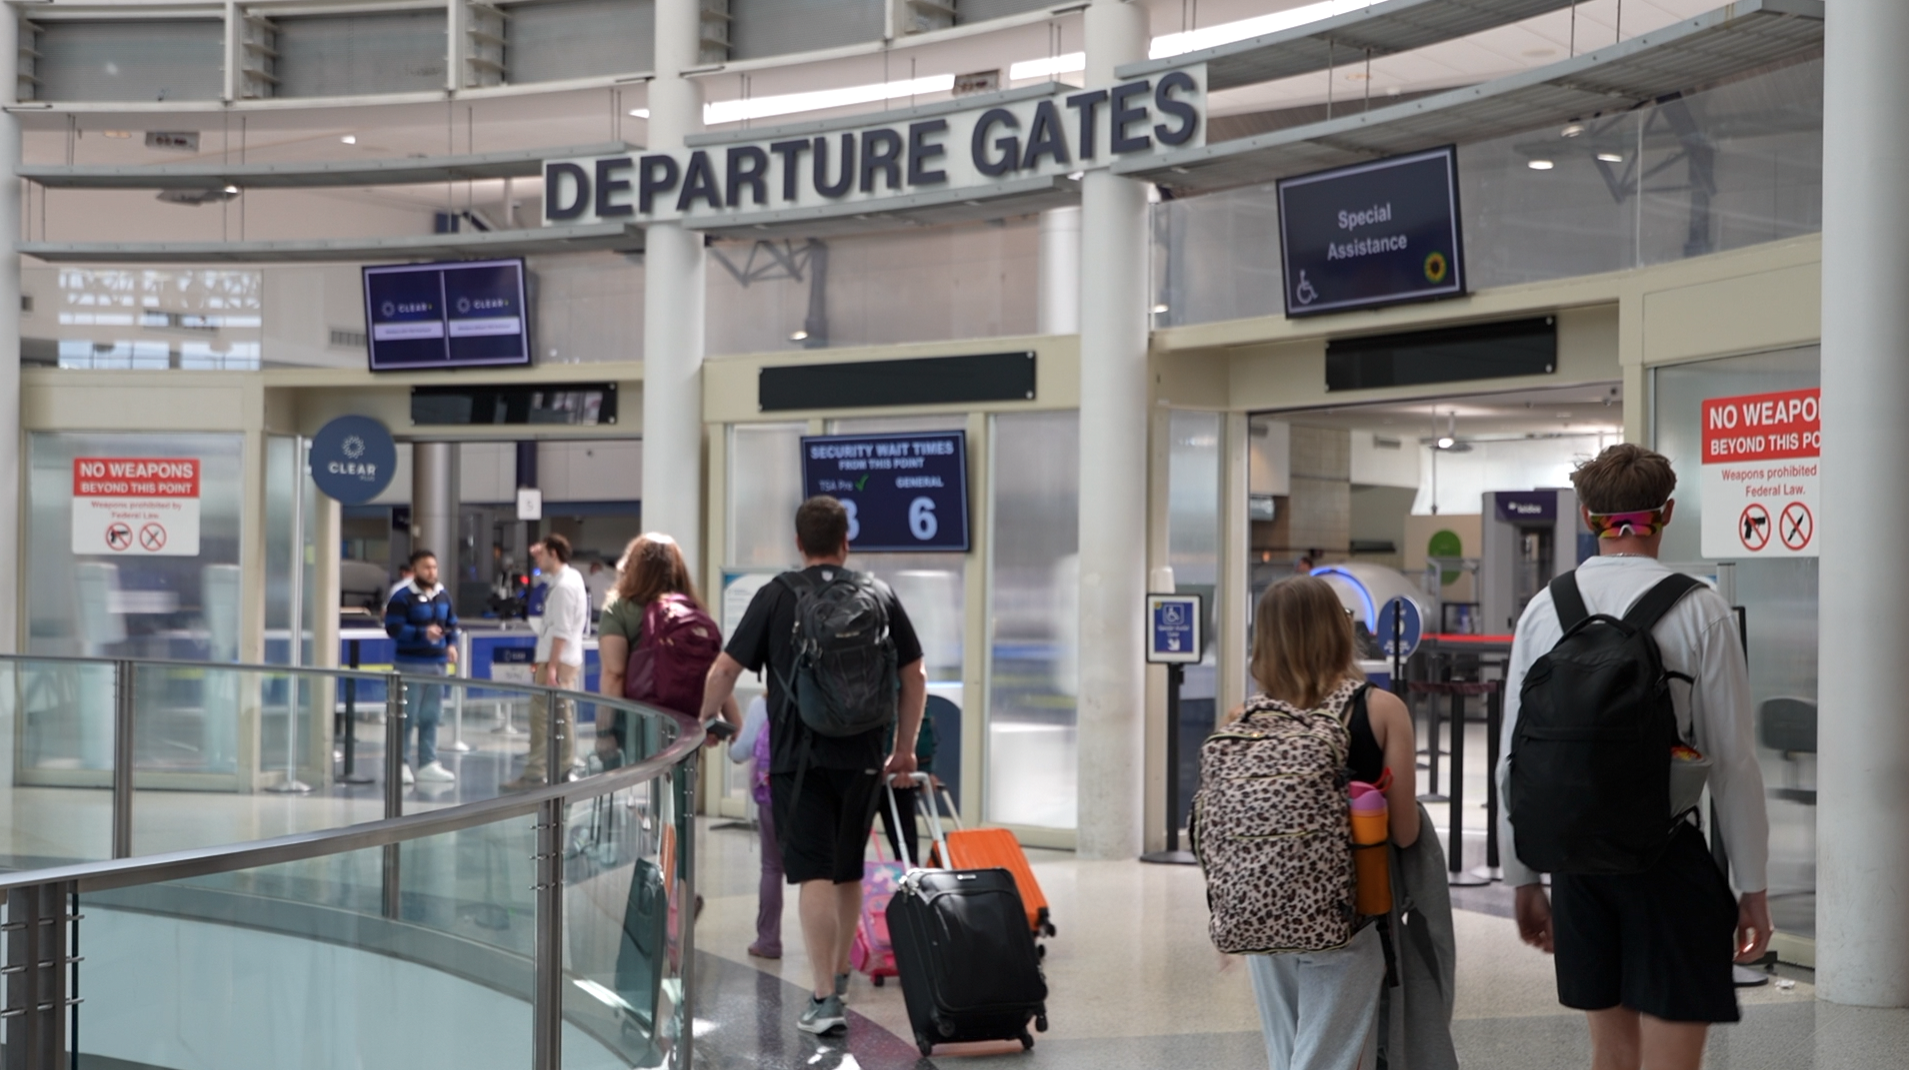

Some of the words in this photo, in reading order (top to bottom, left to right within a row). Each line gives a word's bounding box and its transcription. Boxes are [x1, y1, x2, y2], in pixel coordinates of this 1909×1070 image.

[545, 119, 949, 221] DEPARTURE
[971, 72, 1198, 178] GATES
[1338, 203, 1391, 231] Special
[1327, 235, 1407, 260] Assistance
[1709, 405, 1738, 429] NO
[810, 443, 874, 459] SECURITY
[876, 441, 910, 457] WAIT
[912, 439, 954, 455] TIMES
[1711, 436, 1765, 456] BEYOND
[1768, 432, 1799, 451] THIS
[80, 462, 105, 478] NO
[109, 463, 193, 479] WEAPONS
[328, 461, 377, 475] CLEAR
[838, 459, 867, 471] FROM
[868, 458, 892, 470] THIS
[893, 457, 925, 469] POINT
[895, 476, 944, 488] GENERAL
[1722, 469, 1765, 482] Weapons
[1767, 465, 1817, 481] prohibited
[81, 482, 128, 493] BEYOND
[131, 482, 156, 494] THIS
[158, 482, 193, 494] POINT
[819, 480, 836, 491] TSA
[838, 479, 853, 491] Pre
[1745, 485, 1781, 498] Federal
[1783, 484, 1806, 497] Law.
[91, 500, 127, 510] Weapons
[129, 500, 170, 510] prohibited
[172, 501, 182, 511] by
[908, 496, 938, 540] 6
